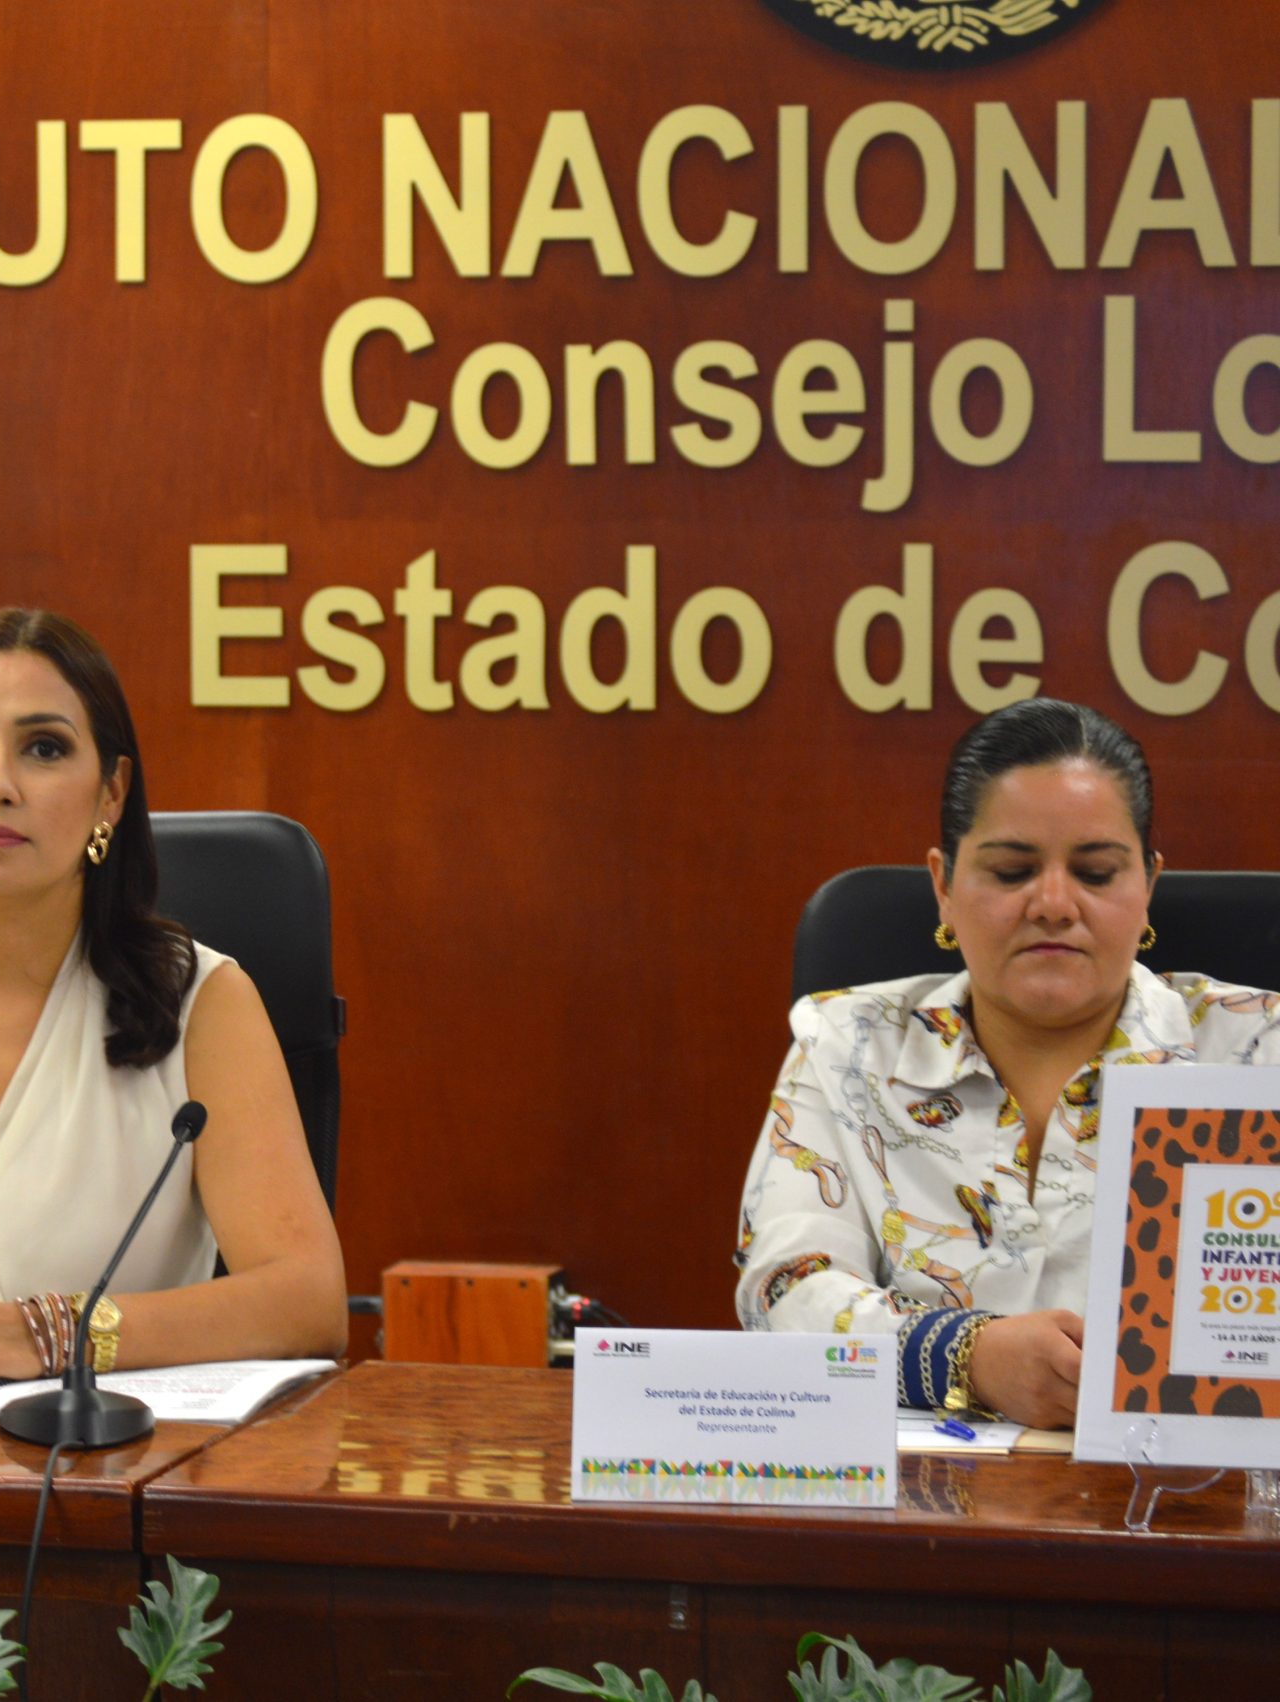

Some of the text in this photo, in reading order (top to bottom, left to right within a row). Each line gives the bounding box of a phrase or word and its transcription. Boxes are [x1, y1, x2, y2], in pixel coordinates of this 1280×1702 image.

[321, 297, 1033, 512] Consejo
[190, 544, 772, 713] Estado
[834, 543, 1043, 713] de
[1203, 1232, 1280, 1248] CONSUL
[1201, 1267, 1213, 1281] Y
[1200, 1285, 1280, 1314] 202
[614, 1342, 650, 1353] INE
[1238, 1352, 1269, 1361] INE
[645, 1388, 832, 1403] Secretaría de Educación y Cultura
[679, 1404, 795, 1418] del Estado de Colima
[696, 1421, 777, 1434] Representante
